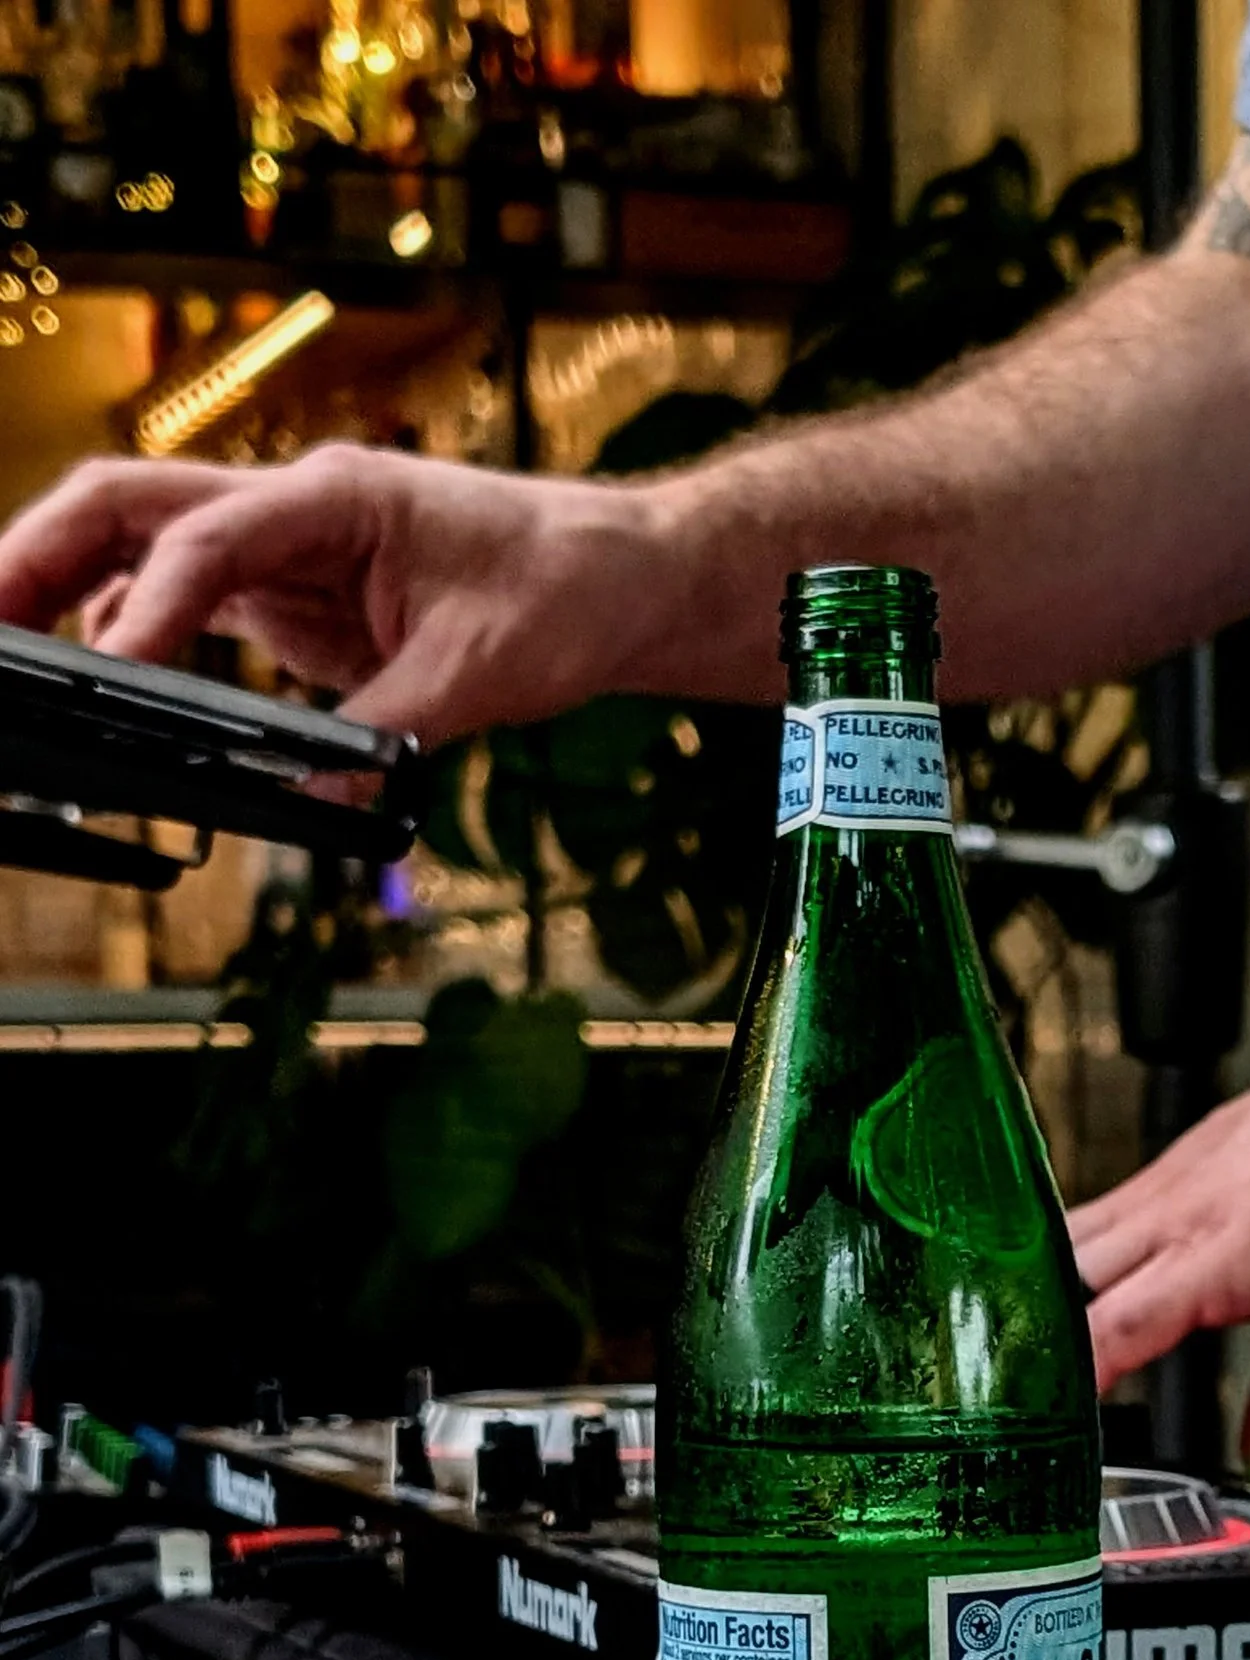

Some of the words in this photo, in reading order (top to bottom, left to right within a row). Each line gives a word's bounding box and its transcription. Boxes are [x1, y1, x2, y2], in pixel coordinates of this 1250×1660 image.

[826, 717, 940, 742] PELLEGRIN
[823, 784, 945, 809] PELLEGRINO
[498, 1554, 598, 1651] Numark
[662, 1605, 718, 1646] Nutrition
[725, 1615, 790, 1650] Facts
